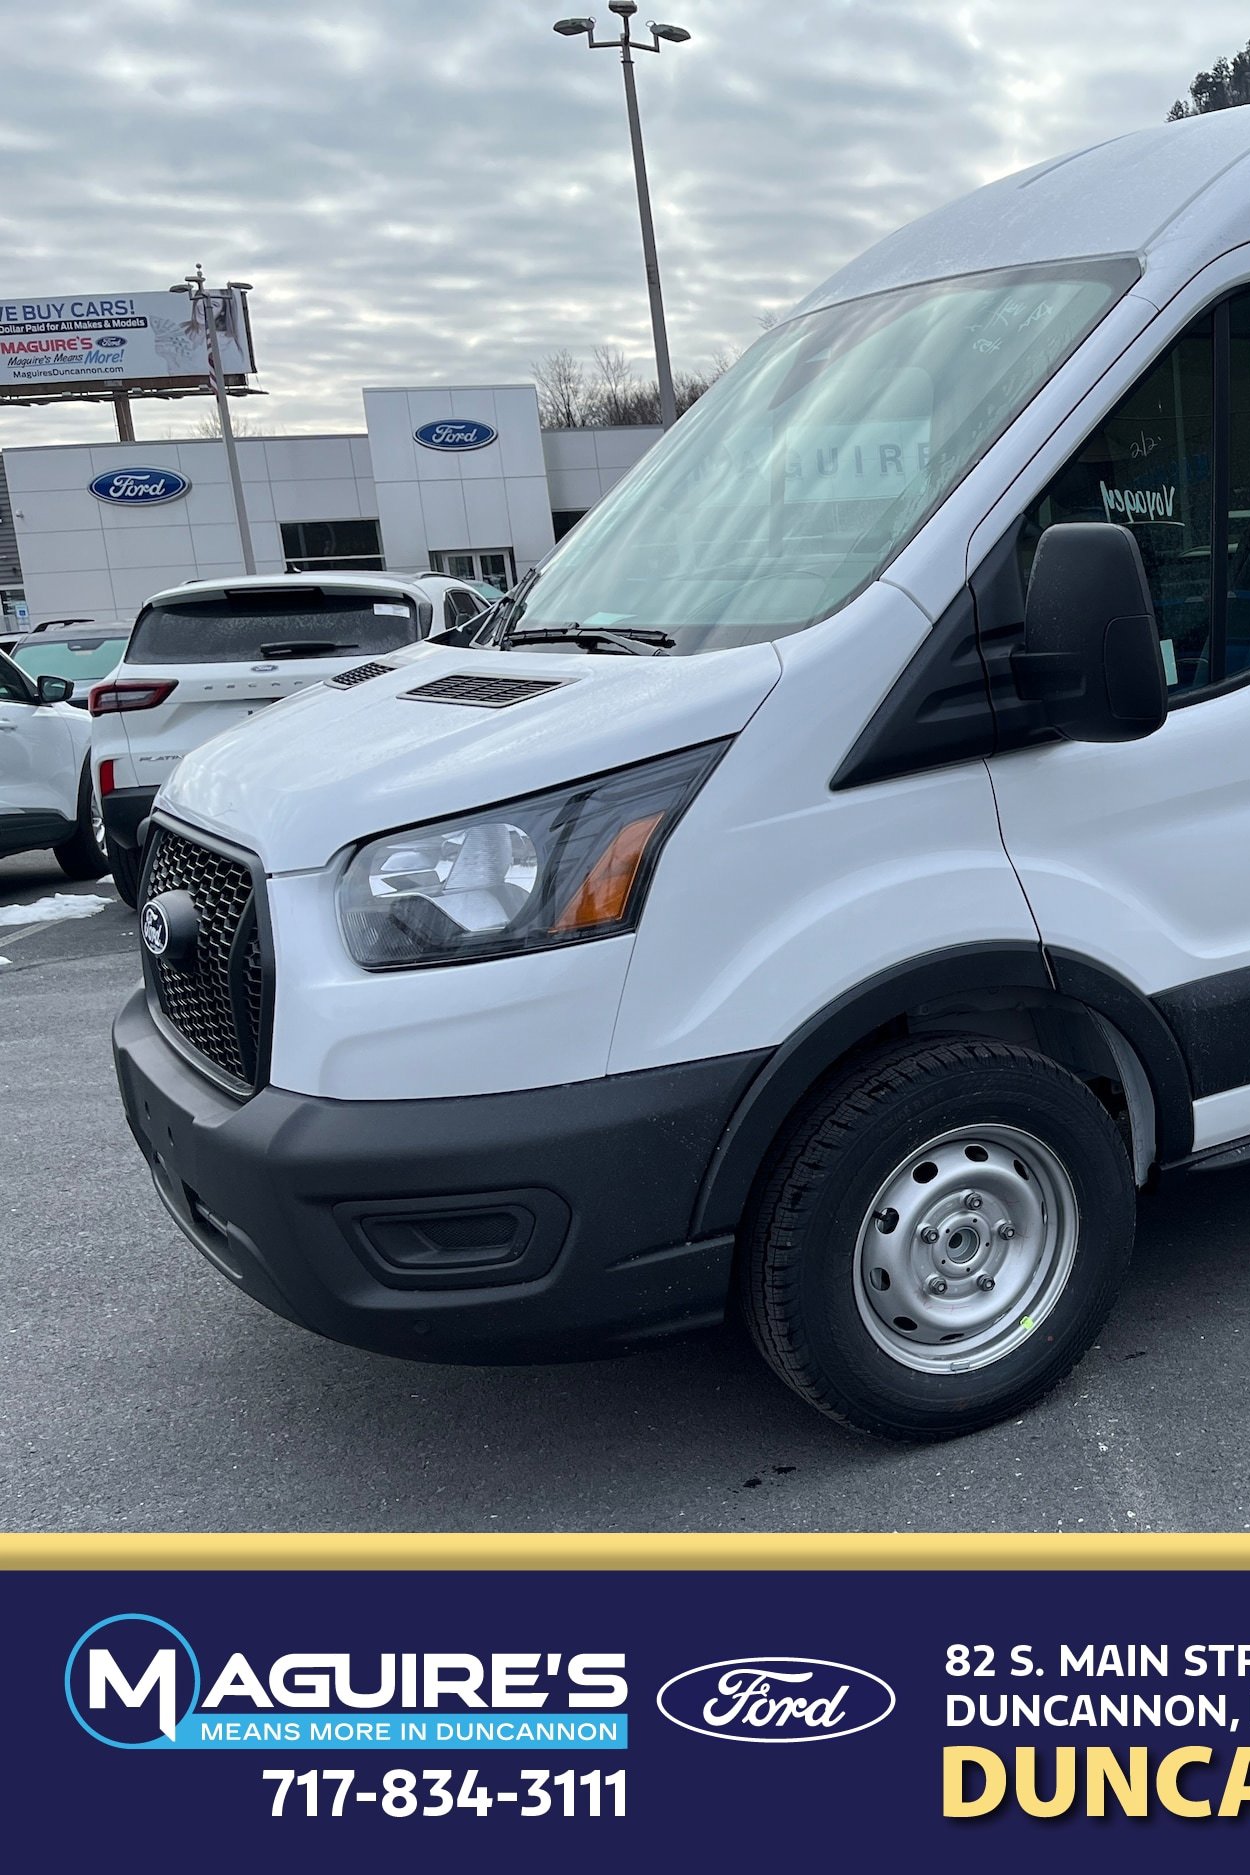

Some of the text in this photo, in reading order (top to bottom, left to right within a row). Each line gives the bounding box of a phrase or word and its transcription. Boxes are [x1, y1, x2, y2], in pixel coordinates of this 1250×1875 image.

[22, 303, 65, 320] BUY
[70, 300, 135, 318] CARS!
[25, 323, 45, 332] Paid
[46, 322, 59, 331] for
[60, 321, 73, 330] All
[74, 320, 103, 330] Makes
[103, 319, 112, 328] &
[112, 318, 145, 328] Models
[0, 336, 93, 354] MAGUIRE'S
[7, 349, 125, 369] Maguire's Means More!
[13, 366, 124, 379] MaguiresDuncannon.com
[434, 424, 478, 443] Ford
[108, 474, 166, 498] Ford
